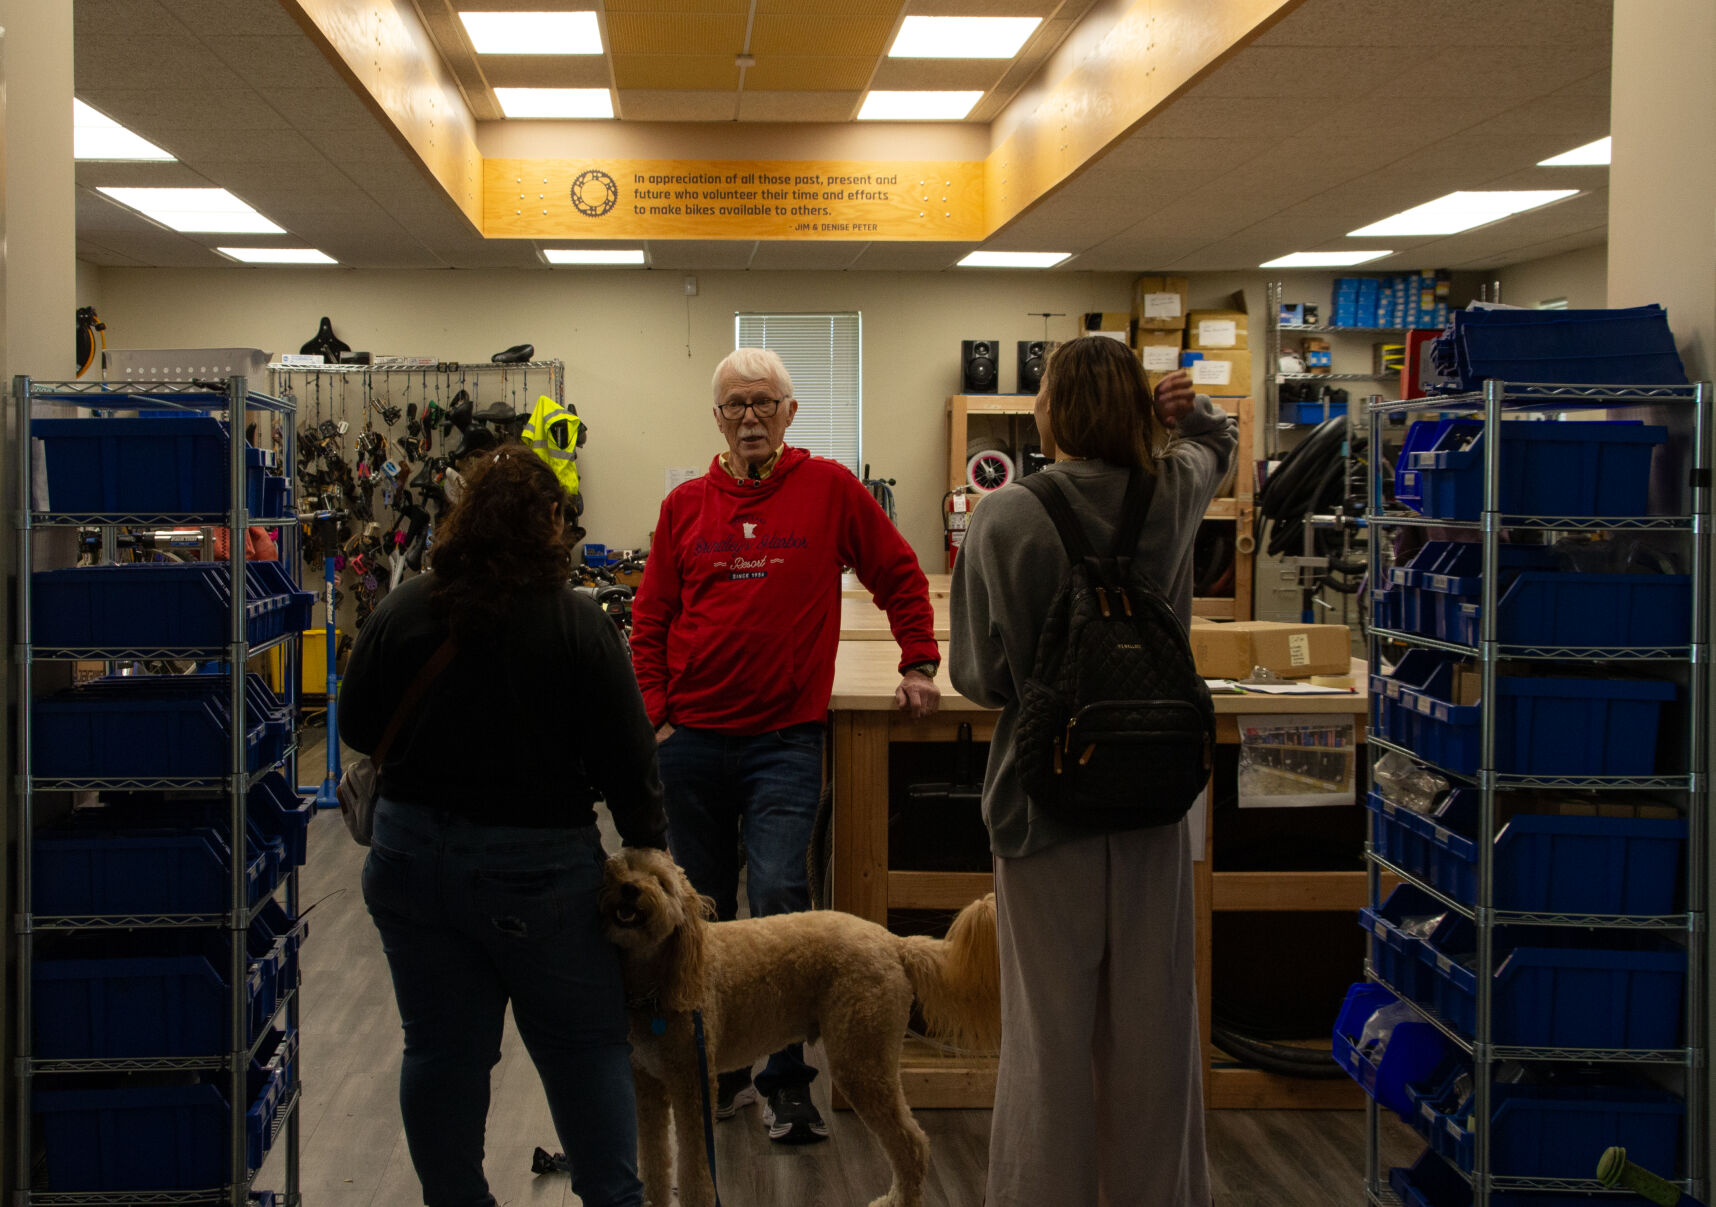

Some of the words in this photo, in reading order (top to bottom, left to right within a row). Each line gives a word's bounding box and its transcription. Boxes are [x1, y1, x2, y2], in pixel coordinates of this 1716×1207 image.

[634, 174, 645, 184] In
[649, 173, 722, 186] appreciation
[725, 173, 738, 184] of
[742, 173, 755, 184] all
[760, 173, 791, 184] those
[794, 174, 823, 186] past,
[827, 175, 871, 186] present
[875, 175, 897, 185] and
[634, 189, 671, 200] future
[675, 189, 699, 200] who
[703, 189, 759, 200] volunteer
[761, 189, 789, 200] their
[792, 189, 819, 200] time
[823, 190, 844, 200] and
[848, 190, 889, 201] efforts
[634, 205, 646, 215] to
[650, 204, 681, 215] make
[686, 204, 716, 215] bikes
[719, 204, 771, 216] available
[775, 205, 787, 215] to
[791, 205, 832, 216] others.
[795, 223, 810, 231] JIM
[813, 223, 818, 231] &
[730, 556, 767, 569] Resort
